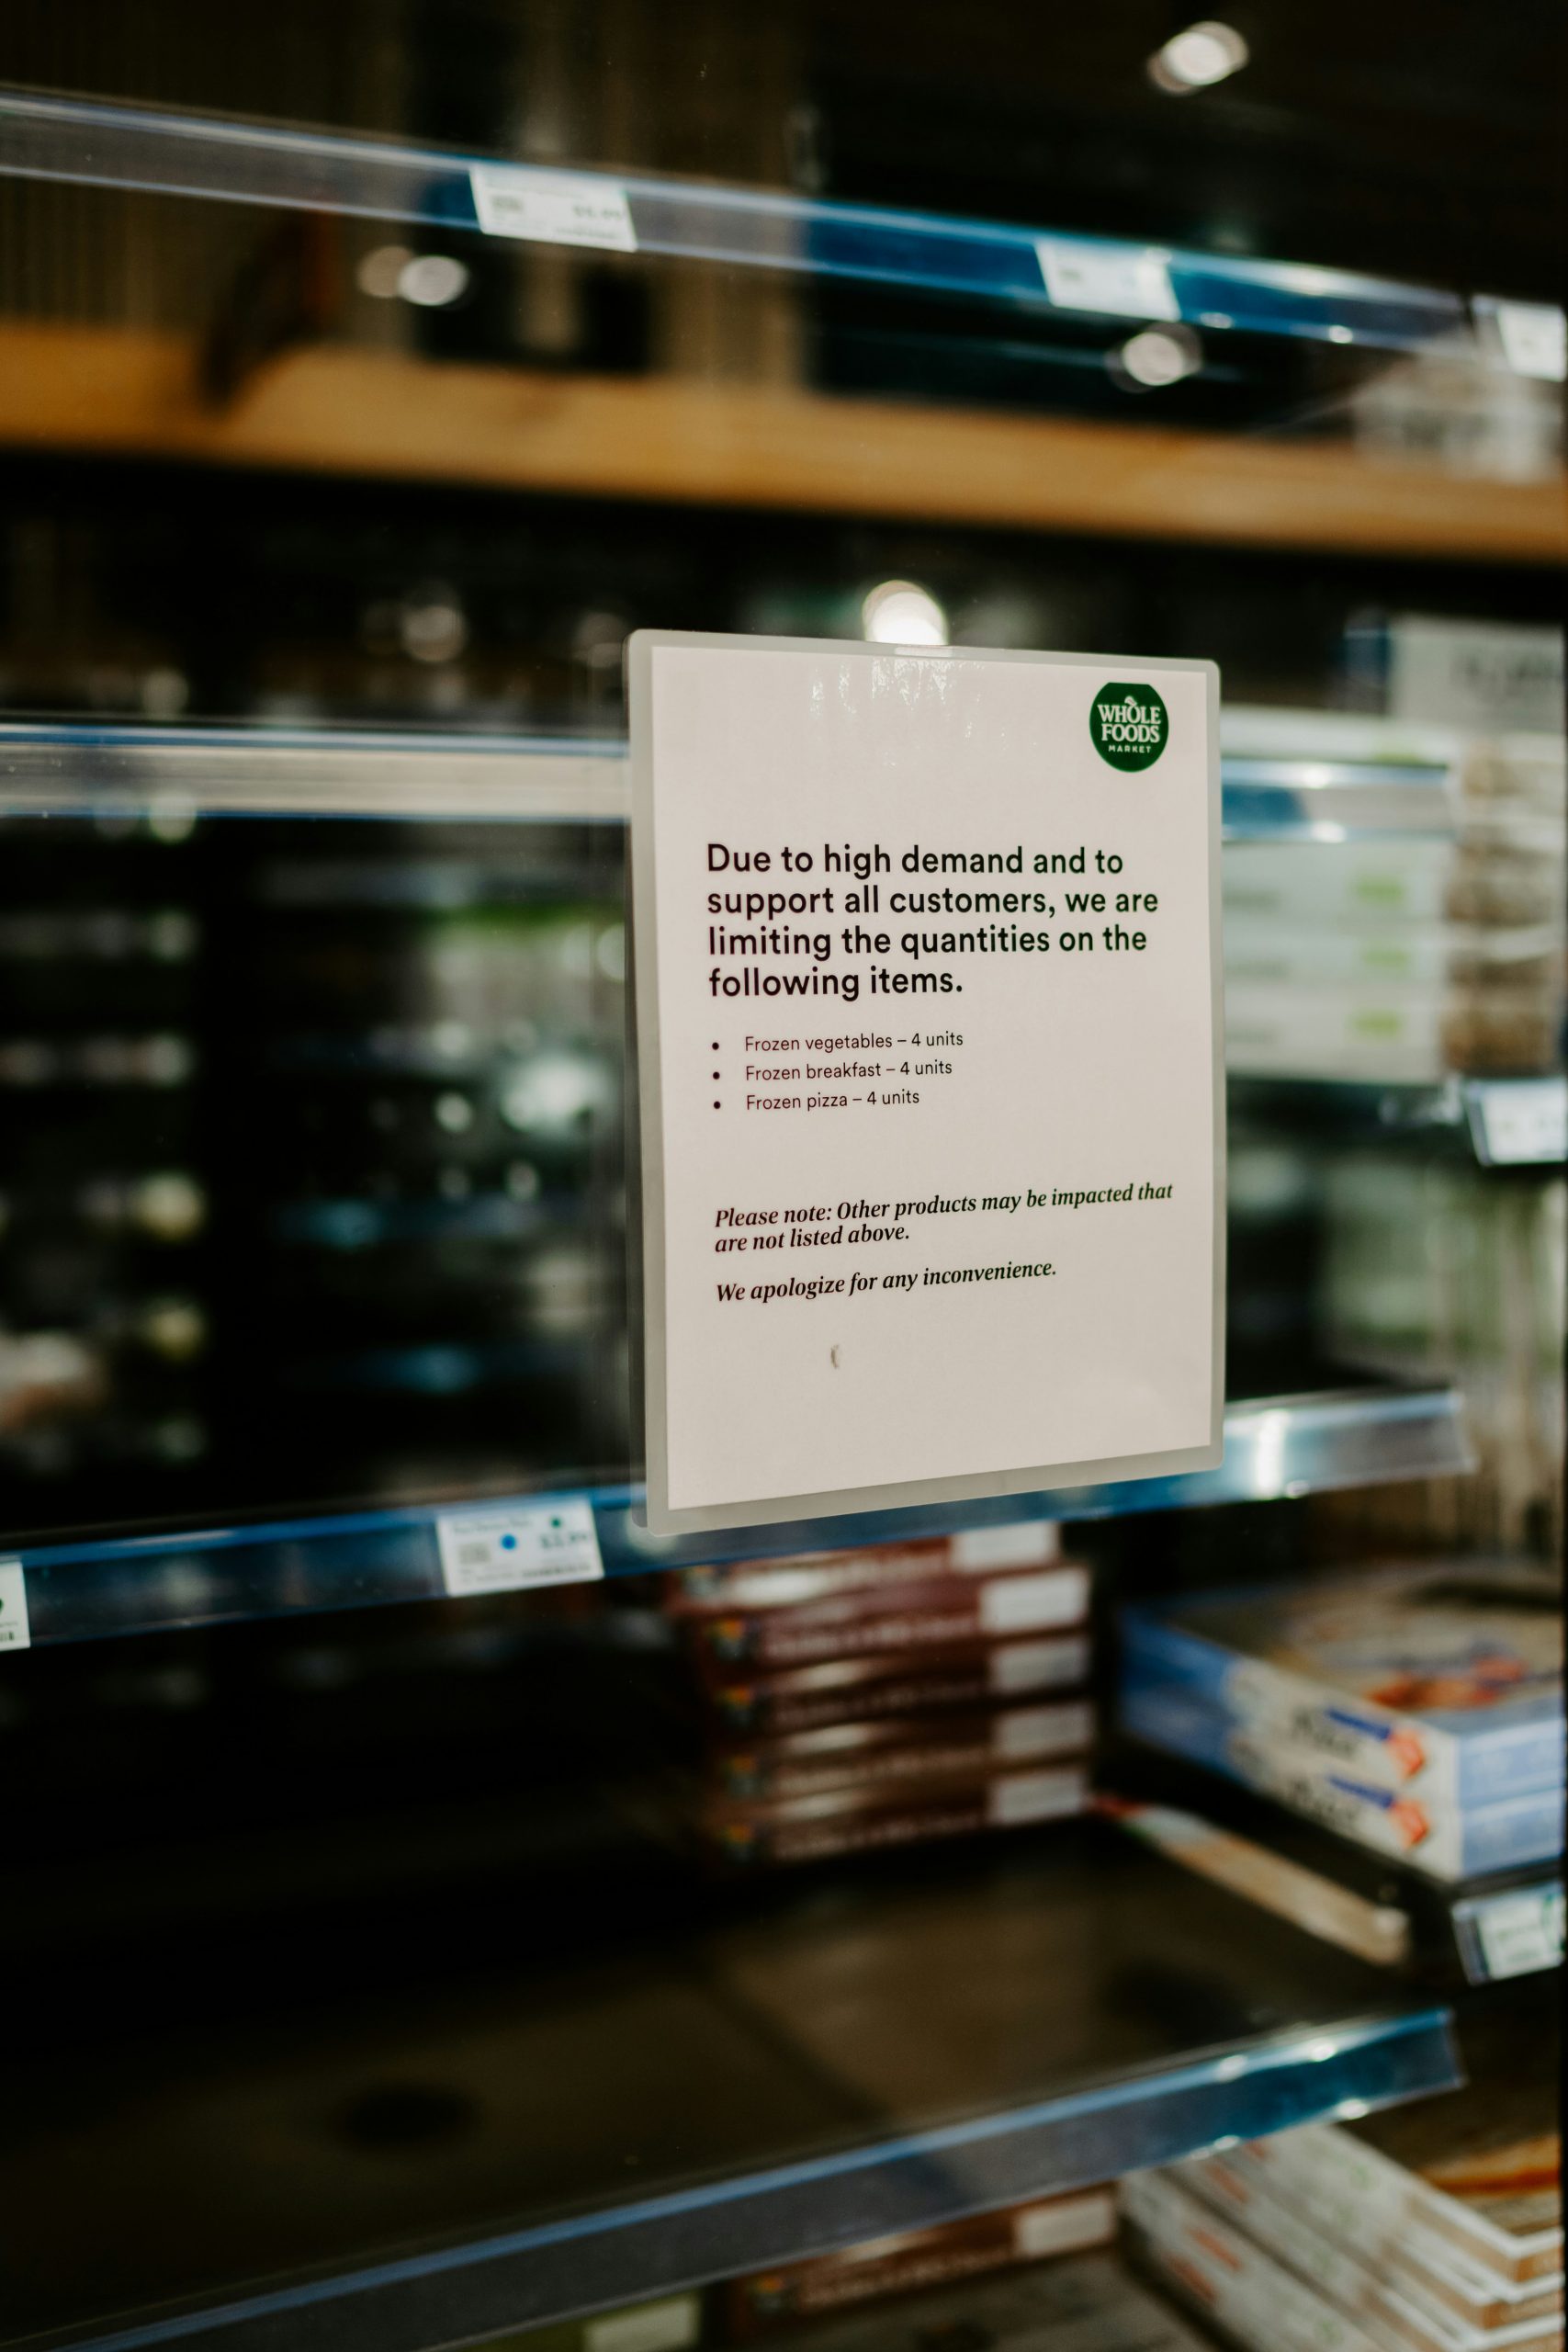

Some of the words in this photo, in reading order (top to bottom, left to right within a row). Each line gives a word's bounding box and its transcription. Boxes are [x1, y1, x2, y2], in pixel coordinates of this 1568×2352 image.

[1098, 705, 1161, 724] WHOLE
[1101, 724, 1160, 743] FOODS
[1109, 745, 1151, 753] MARKET
[707, 843, 771, 872] Due
[781, 847, 813, 873] to
[825, 843, 890, 880] high
[902, 844, 1022, 874] demand
[1033, 846, 1085, 874] and
[1095, 850, 1122, 874] to
[707, 888, 834, 921] support
[845, 885, 878, 913] all
[890, 888, 1055, 918] customers,
[1065, 893, 1106, 912] we
[1115, 893, 1158, 912] are
[709, 925, 830, 962] limiting
[841, 925, 891, 954] the
[901, 924, 1050, 960] quantities
[1059, 933, 1093, 952] on
[1102, 923, 1146, 951] the
[709, 966, 859, 1001] following
[871, 966, 962, 993] items.
[746, 1036, 799, 1051] Frozen
[806, 1033, 892, 1053] vegetables
[911, 1033, 921, 1046] 4
[927, 1031, 963, 1046] units
[746, 1066, 800, 1080] Frozen
[807, 1062, 881, 1079] breakfast
[900, 1061, 909, 1075] 4
[916, 1059, 952, 1075] units
[747, 1095, 801, 1110] Frozen
[807, 1092, 847, 1112] pizza
[867, 1091, 876, 1105] 4
[883, 1089, 919, 1104] units
[715, 1207, 778, 1227] Please
[784, 1205, 831, 1223] note:
[837, 1199, 890, 1219] Other
[894, 1194, 976, 1221] products
[982, 1196, 1021, 1213] may
[1027, 1189, 1046, 1207] be
[1052, 1183, 1134, 1209] impacted
[1138, 1182, 1173, 1200] that
[716, 1238, 747, 1252] are
[753, 1232, 785, 1250] not
[790, 1225, 843, 1247] listed
[848, 1224, 908, 1243] above.
[716, 1283, 745, 1302] We
[750, 1276, 845, 1304] apologize
[848, 1272, 878, 1296] for
[883, 1273, 918, 1292] any
[923, 1261, 1055, 1285] inconvenience.
